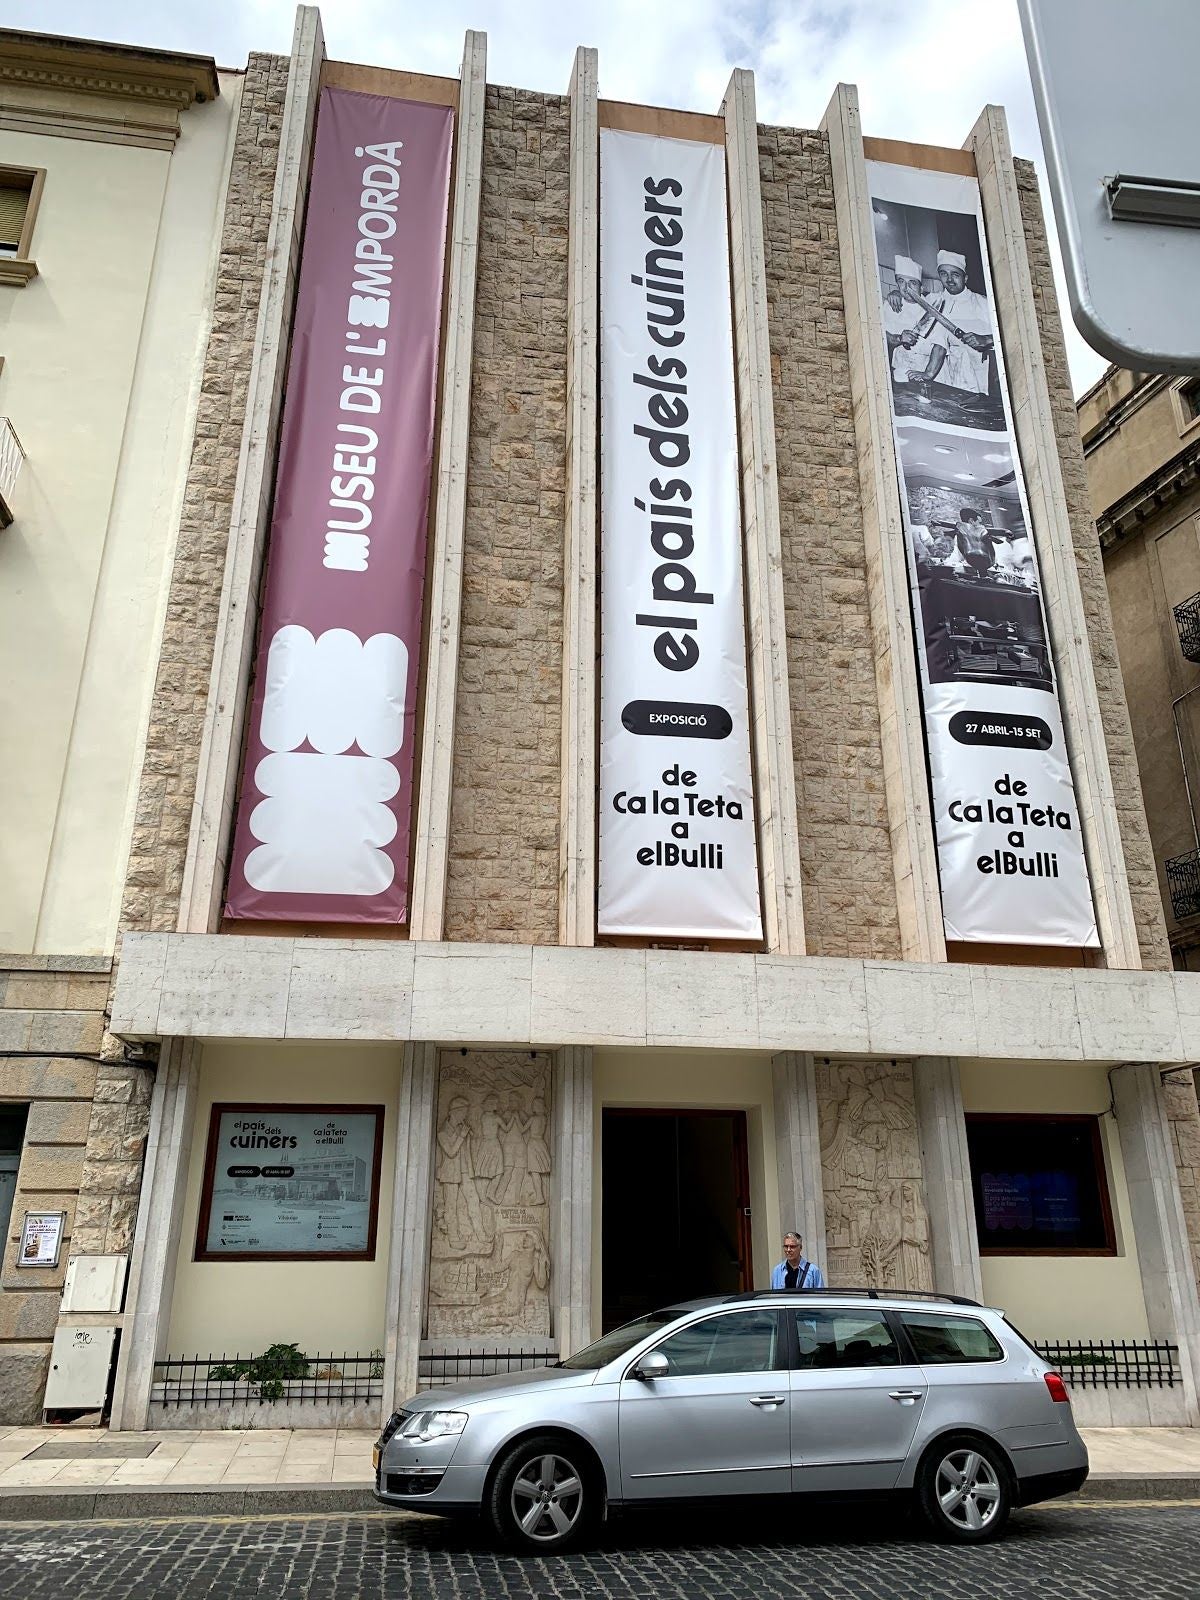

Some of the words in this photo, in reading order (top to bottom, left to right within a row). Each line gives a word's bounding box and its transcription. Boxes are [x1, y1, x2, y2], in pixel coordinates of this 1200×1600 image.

[630, 176, 686, 348] cuiners
[339, 364, 384, 414] DE
[632, 354, 691, 468] dels
[322, 423, 379, 572] MUSEU
[634, 477, 714, 604] país
[635, 613, 700, 672] el
[649, 713, 707, 726] EXPOSICIÓ
[965, 723, 978, 733] 27
[1026, 728, 1042, 739] SET
[662, 763, 698, 787] de
[994, 773, 1028, 797] de
[613, 791, 647, 814] Ca
[653, 790, 680, 815] la
[684, 793, 743, 820] Teta
[948, 800, 983, 823] Ca
[987, 799, 1014, 825] la
[1016, 802, 1072, 830] Teta
[671, 821, 689, 839] a
[1007, 830, 1025, 848] a
[636, 841, 723, 869] elBulli
[976, 849, 1059, 878] elBulli
[233, 1120, 242, 1129] el
[242, 1120, 266, 1133] país
[264, 1126, 282, 1135] dels
[313, 1128, 322, 1136] Ca
[323, 1128, 331, 1136] la
[331, 1128, 348, 1136] Teta
[326, 1121, 336, 1129] de
[229, 1131, 298, 1149] cuiners
[321, 1137, 344, 1145] elBulli
